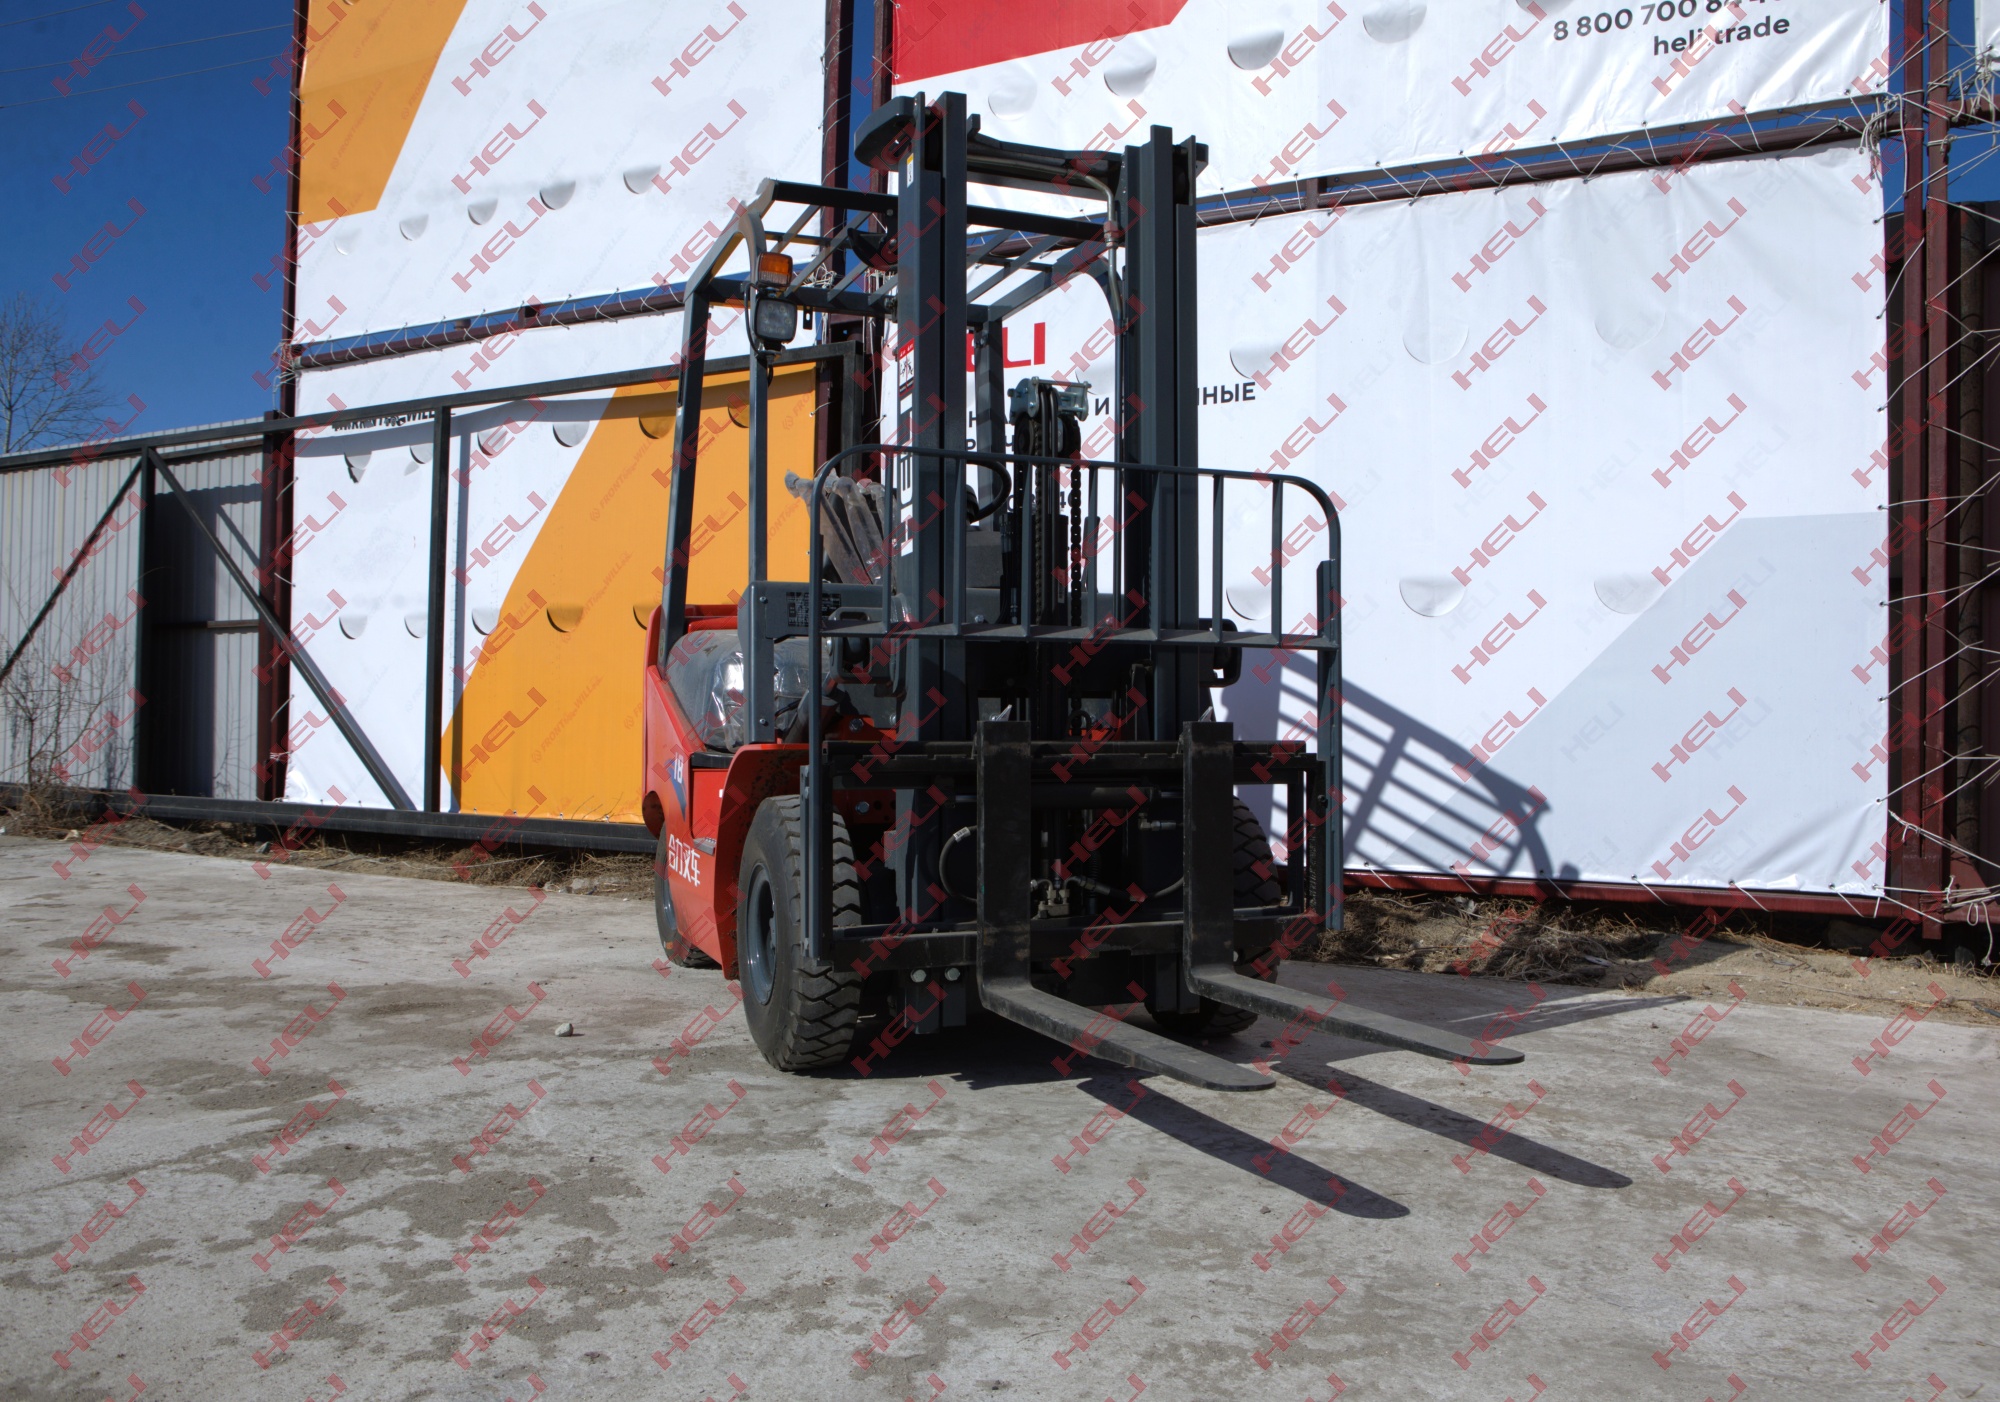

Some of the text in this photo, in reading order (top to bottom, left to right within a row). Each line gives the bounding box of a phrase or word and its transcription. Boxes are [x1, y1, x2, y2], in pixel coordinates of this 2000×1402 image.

[1553, 20, 1569, 41] 8
[1576, 8, 1633, 37] 800
[1640, 0, 1699, 26] 700
